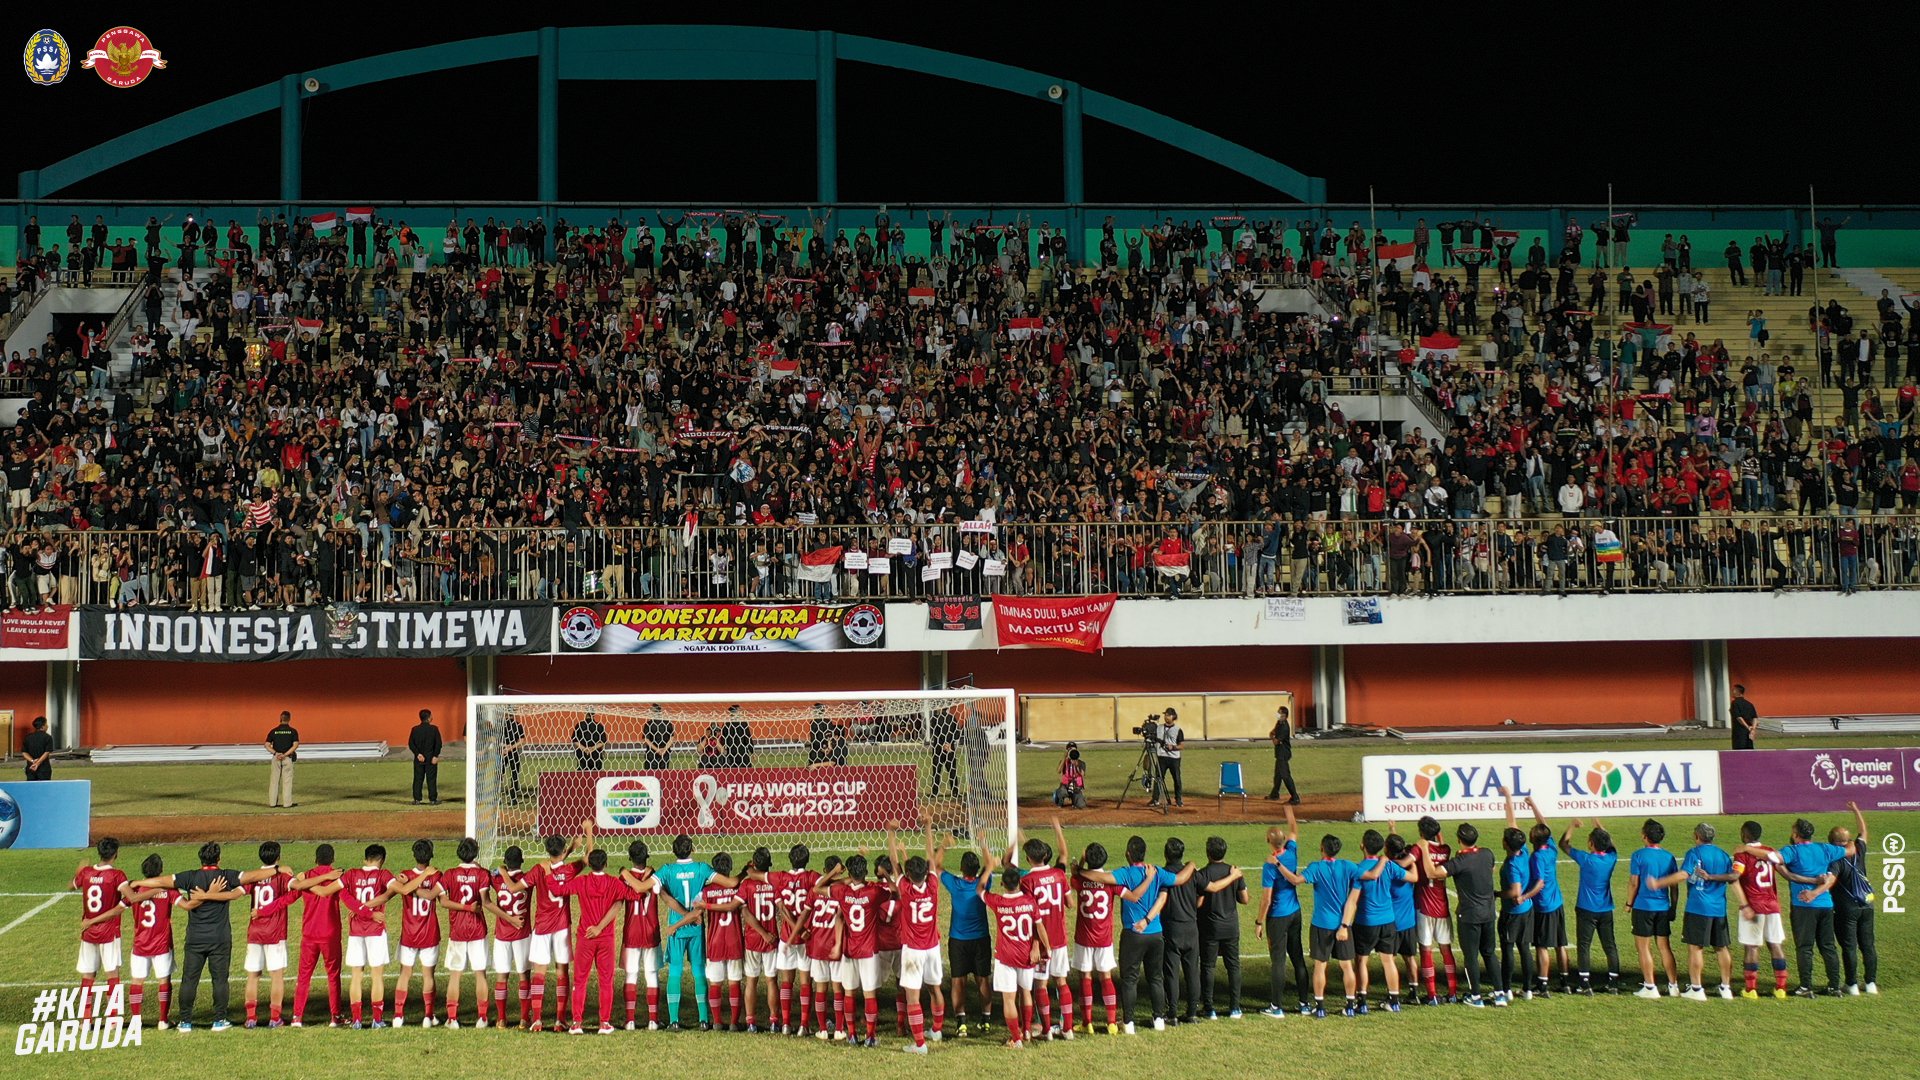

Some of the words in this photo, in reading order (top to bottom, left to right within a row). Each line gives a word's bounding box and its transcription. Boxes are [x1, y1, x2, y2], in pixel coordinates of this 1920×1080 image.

[678, 430, 732, 438] INDONESIA
[962, 521, 992, 530] ALLAH
[604, 608, 731, 625] INDONESIA
[734, 608, 808, 625] JUARA
[816, 608, 843, 624] !!!
[930, 606, 942, 620] 19
[964, 606, 979, 620] 45
[999, 604, 1033, 619] TIMNAS
[1034, 607, 1060, 621] DULU,
[1061, 606, 1085, 618] BARU
[3, 618, 18, 626] LOVE
[332, 609, 527, 650] STIMEWA
[1008, 623, 1074, 636] MARKITU
[104, 613, 318, 654] INDONESIA
[638, 627, 748, 642] MARKITU
[750, 626, 800, 641] SON
[718, 644, 760, 652] FOOTBALL
[1841, 758, 1893, 772] Premier
[1842, 772, 1894, 788] League
[727, 783, 764, 798] FIFA
[765, 782, 830, 797] WORLD
[832, 781, 867, 795] CUP
[602, 797, 655, 808] INDOSIAR
[806, 799, 858, 815] 2022
[1384, 803, 1427, 814] SPORTS
[1429, 802, 1486, 812] MEDICINE
[1558, 800, 1599, 810] SPORTS
[1602, 799, 1658, 809] MEDICINE
[1660, 798, 1703, 808] CENTRE
[1755, 860, 1773, 888] 21
[87, 885, 102, 913] 8
[498, 890, 527, 915] 22
[682, 880, 690, 910] 1
[1034, 883, 1062, 916] 24
[754, 893, 774, 921] 15
[909, 902, 933, 924] 12
[1080, 890, 1109, 919] 23
[140, 900, 156, 927] 3
[849, 904, 865, 932] 9
[1000, 914, 1033, 941] 20
